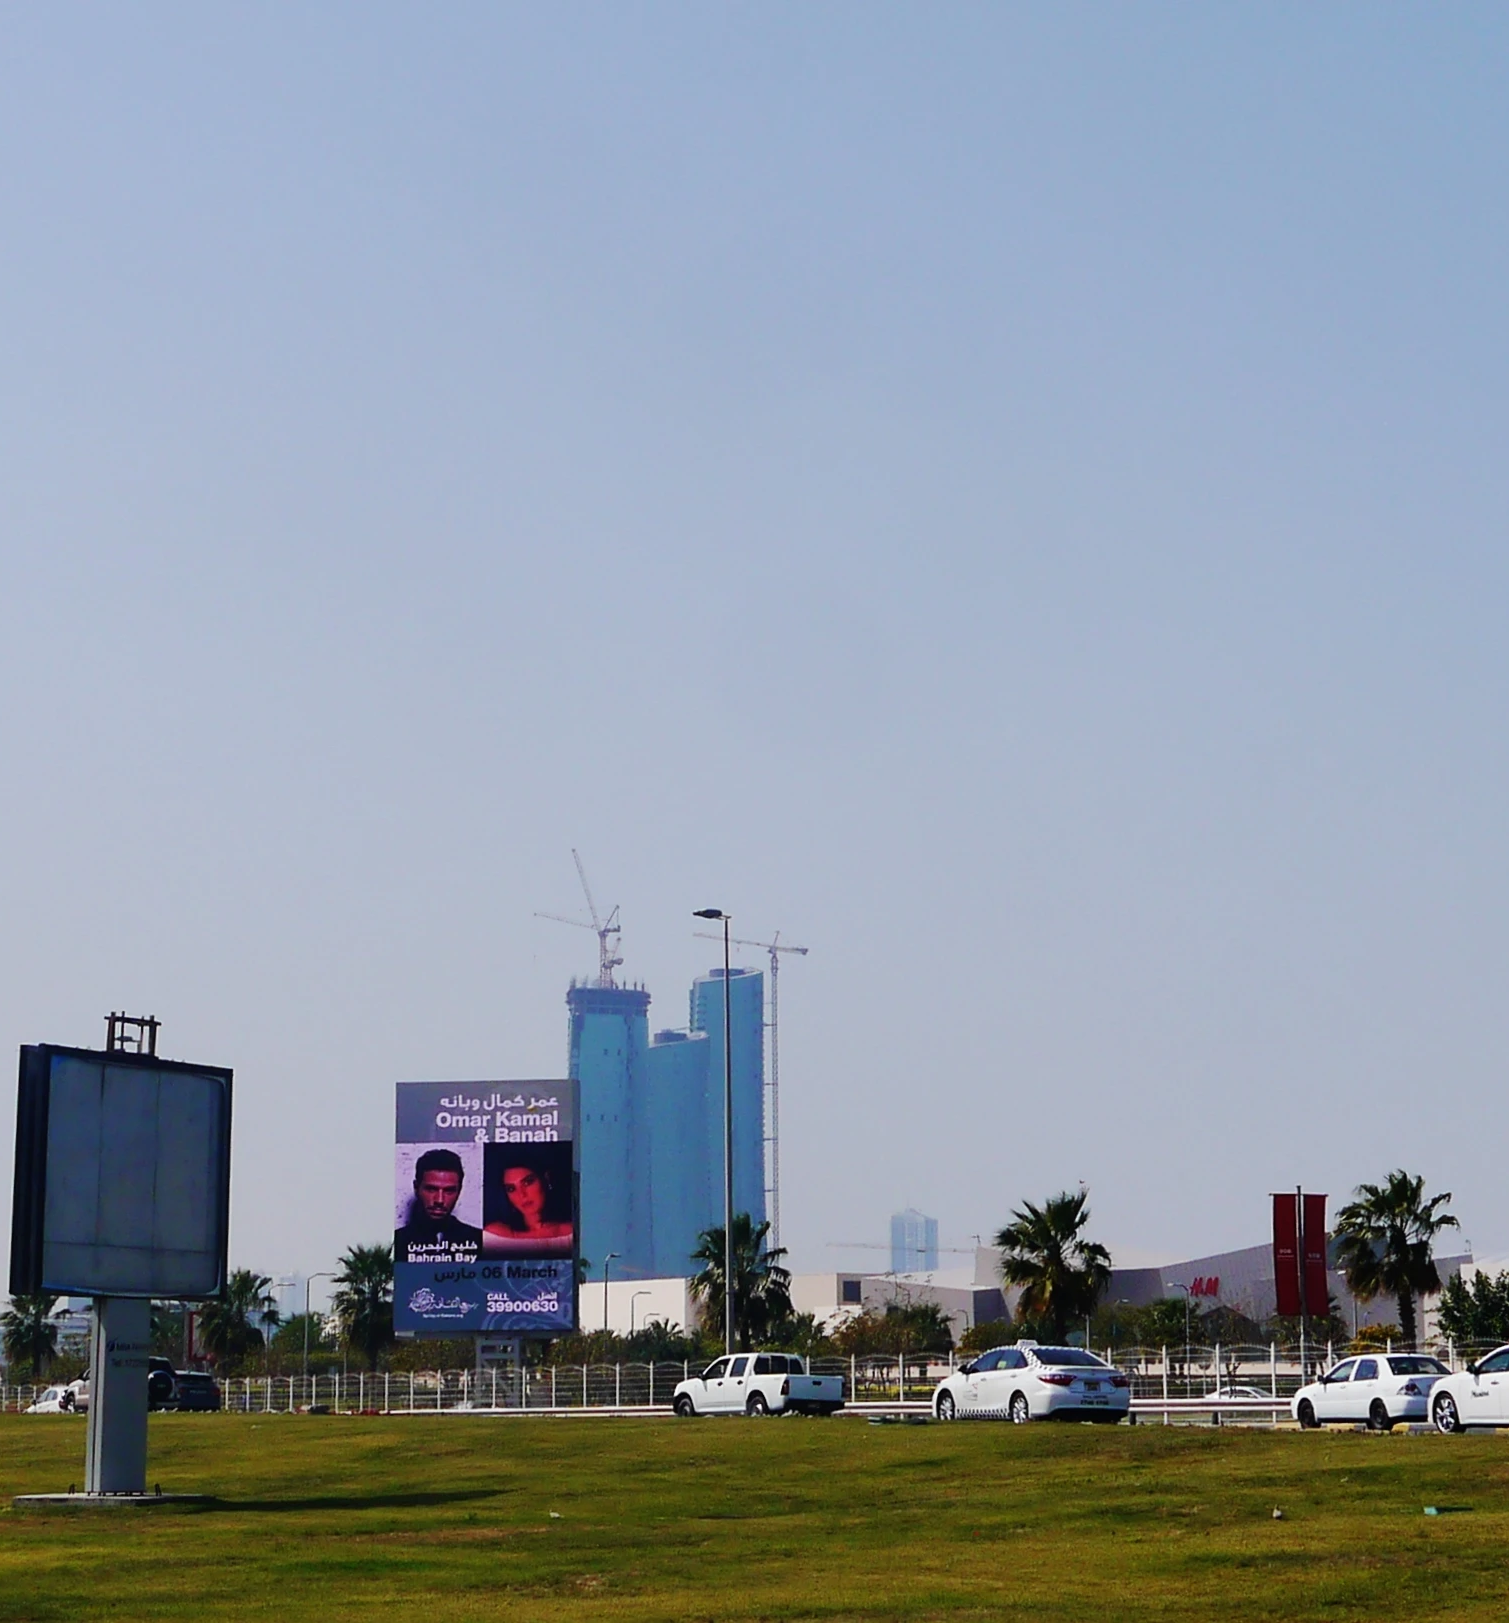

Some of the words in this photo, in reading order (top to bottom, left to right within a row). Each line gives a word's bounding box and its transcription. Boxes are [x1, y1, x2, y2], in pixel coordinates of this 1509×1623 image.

[483, 1093, 525, 1111] كمال
[527, 1096, 559, 1110] عمر
[436, 1112, 491, 1128] Omar
[495, 1110, 559, 1127] Kamal
[474, 1128, 490, 1143] &
[494, 1126, 559, 1143] Banah
[407, 1240, 449, 1253] البحرين
[450, 1240, 478, 1252] خليج
[407, 1253, 452, 1263] Bahrain
[454, 1253, 478, 1264] Bay
[434, 1267, 476, 1282] مارس
[481, 1267, 503, 1279] 06
[507, 1266, 558, 1279] March
[487, 1293, 509, 1301] CALL
[486, 1301, 559, 1312] 39900630
